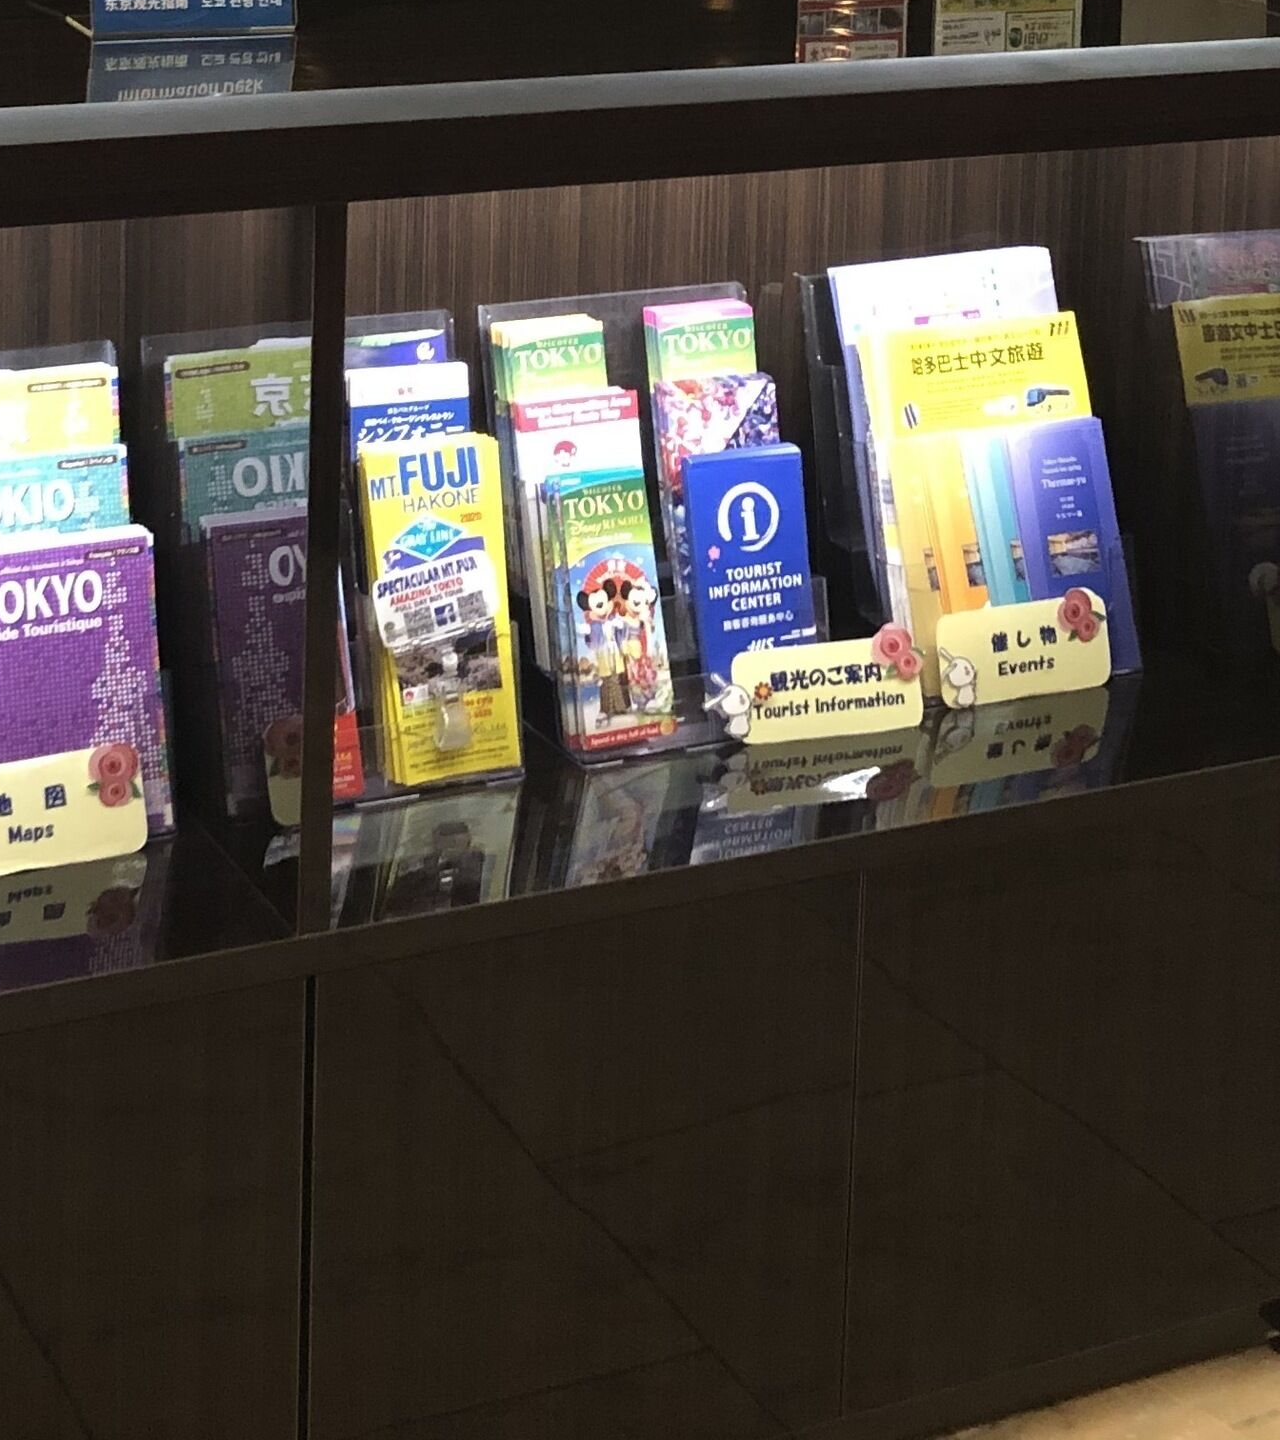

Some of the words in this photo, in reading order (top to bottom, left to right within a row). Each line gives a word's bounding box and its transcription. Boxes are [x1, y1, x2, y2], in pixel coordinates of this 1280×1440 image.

[663, 327, 752, 356] TOKYO
[514, 343, 603, 374] TOKYO
[370, 475, 401, 502] MT.
[399, 446, 480, 496] FUJI
[403, 487, 481, 513] HAKONE
[564, 489, 644, 520] TOKYO
[377, 565, 441, 600] SPECTACULAR
[726, 561, 783, 581] TOURIST
[390, 586, 432, 607] AMAZING
[433, 577, 464, 594] TOKYO
[708, 573, 802, 600] INFORMATION
[731, 591, 782, 611] CENTER
[23, 615, 103, 638] Touristique
[991, 624, 1058, 653] 催し物
[770, 662, 882, 692] 観光のご案内
[998, 654, 1055, 677] Events
[754, 699, 810, 720] Tourist
[816, 691, 905, 714] Information
[8, 824, 54, 844] Maps
